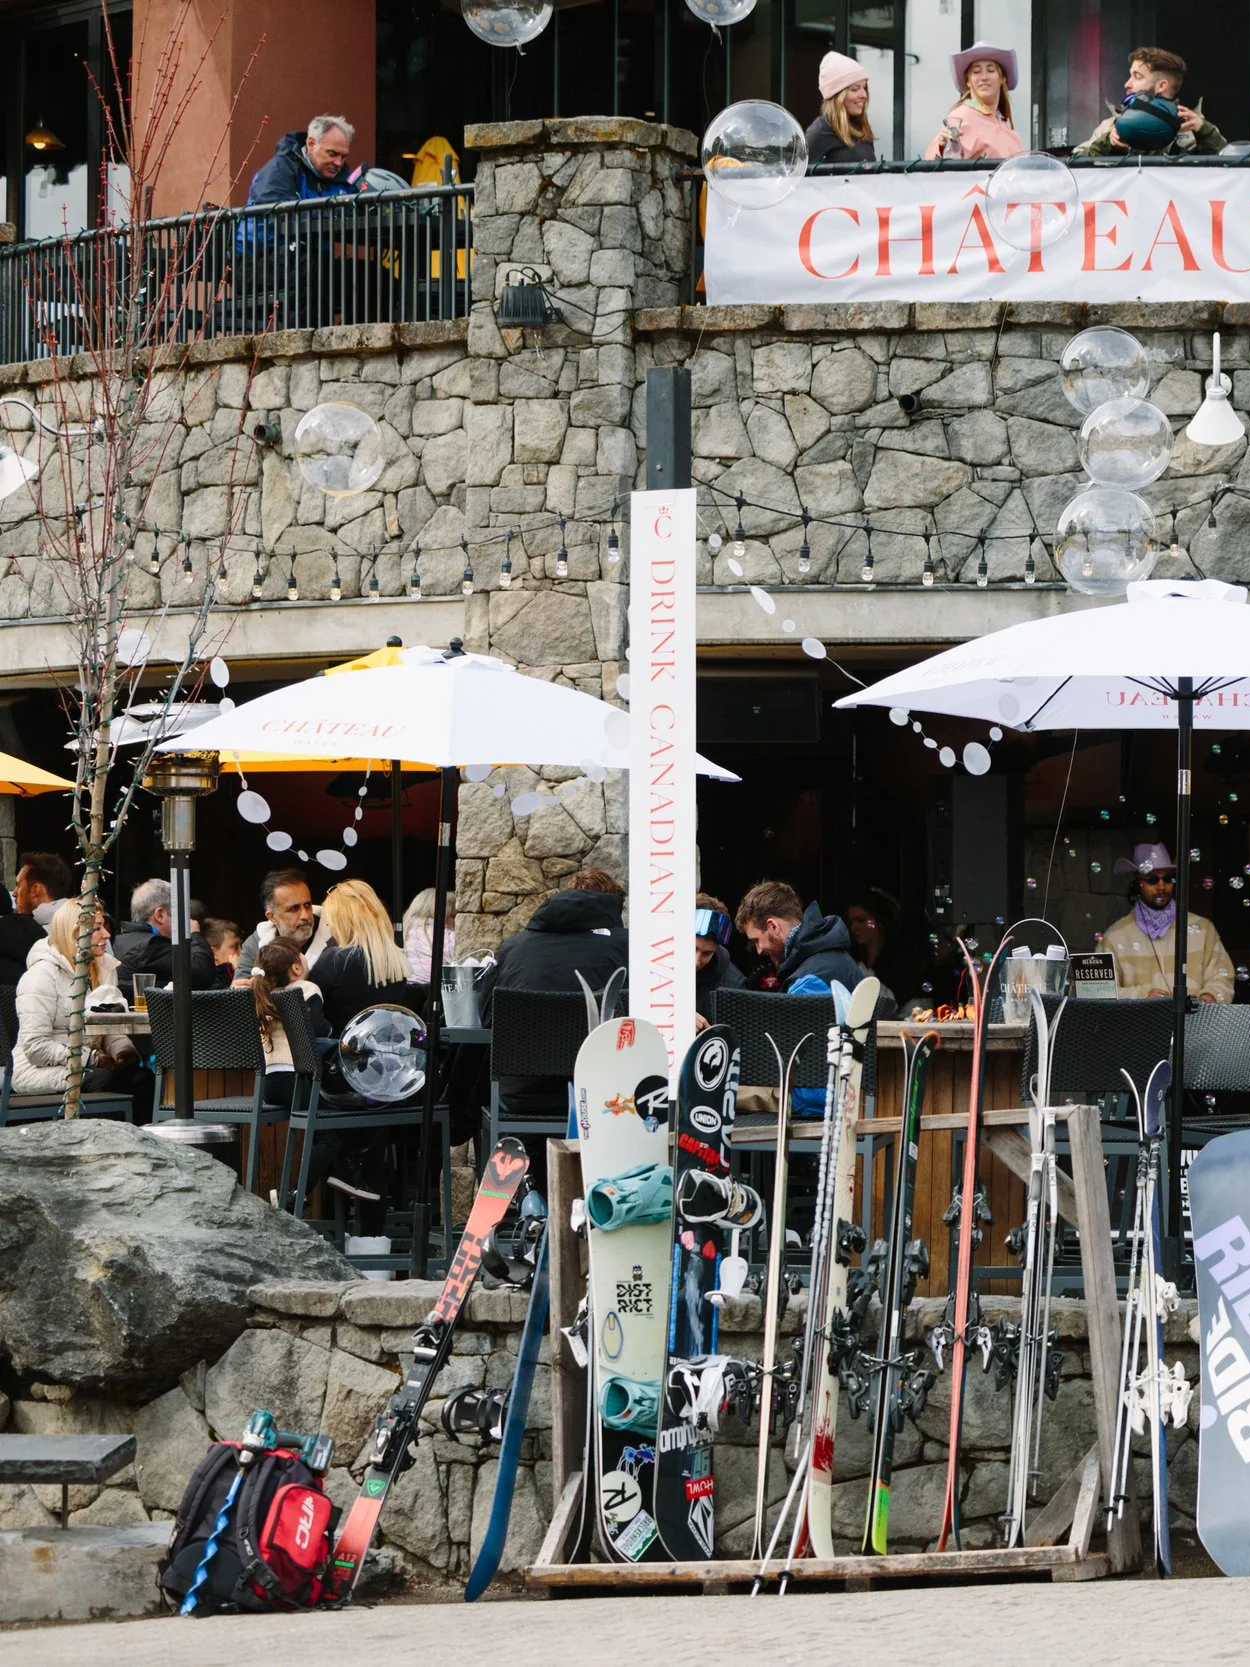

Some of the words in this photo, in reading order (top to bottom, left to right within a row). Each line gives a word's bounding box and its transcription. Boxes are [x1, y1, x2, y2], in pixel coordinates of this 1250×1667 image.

[650, 560, 676, 681] DRINK
[649, 704, 675, 915] CANADIAN
[1075, 968, 1114, 979] RESERVED
[695, 1112, 717, 1126] UNION
[616, 1283, 653, 1298] DIST
[617, 1298, 653, 1313] RICT
[686, 1480, 714, 1495] HOWL
[337, 1552, 357, 1562] A12
